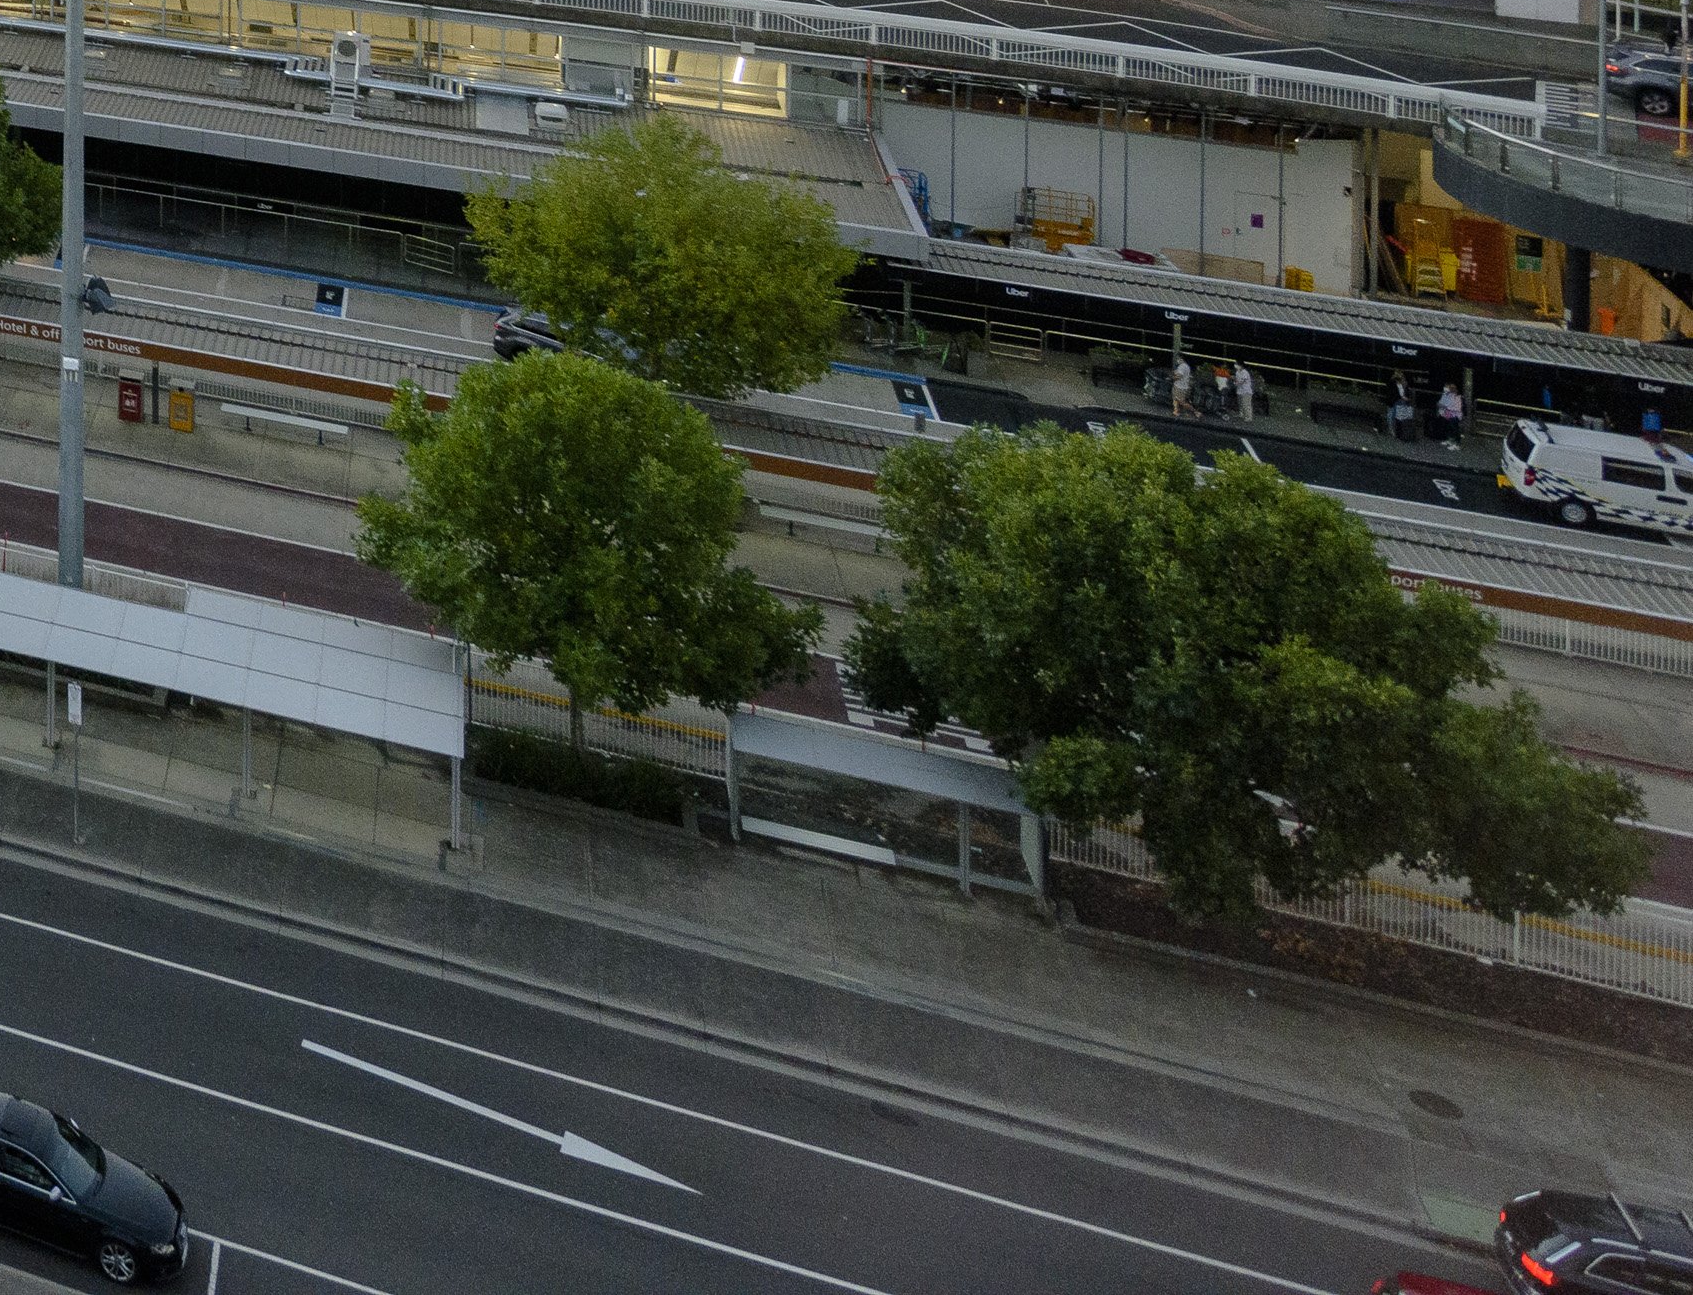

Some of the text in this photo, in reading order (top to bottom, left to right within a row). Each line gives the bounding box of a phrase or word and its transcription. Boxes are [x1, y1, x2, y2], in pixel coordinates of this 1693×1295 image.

[1006, 287, 1030, 298] Uber
[1165, 310, 1190, 322] Uber
[30, 325, 40, 337] &
[42, 327, 61, 340] off
[107, 337, 141, 355] buses
[1392, 345, 1418, 356] Uber
[1638, 382, 1666, 394] Uber
